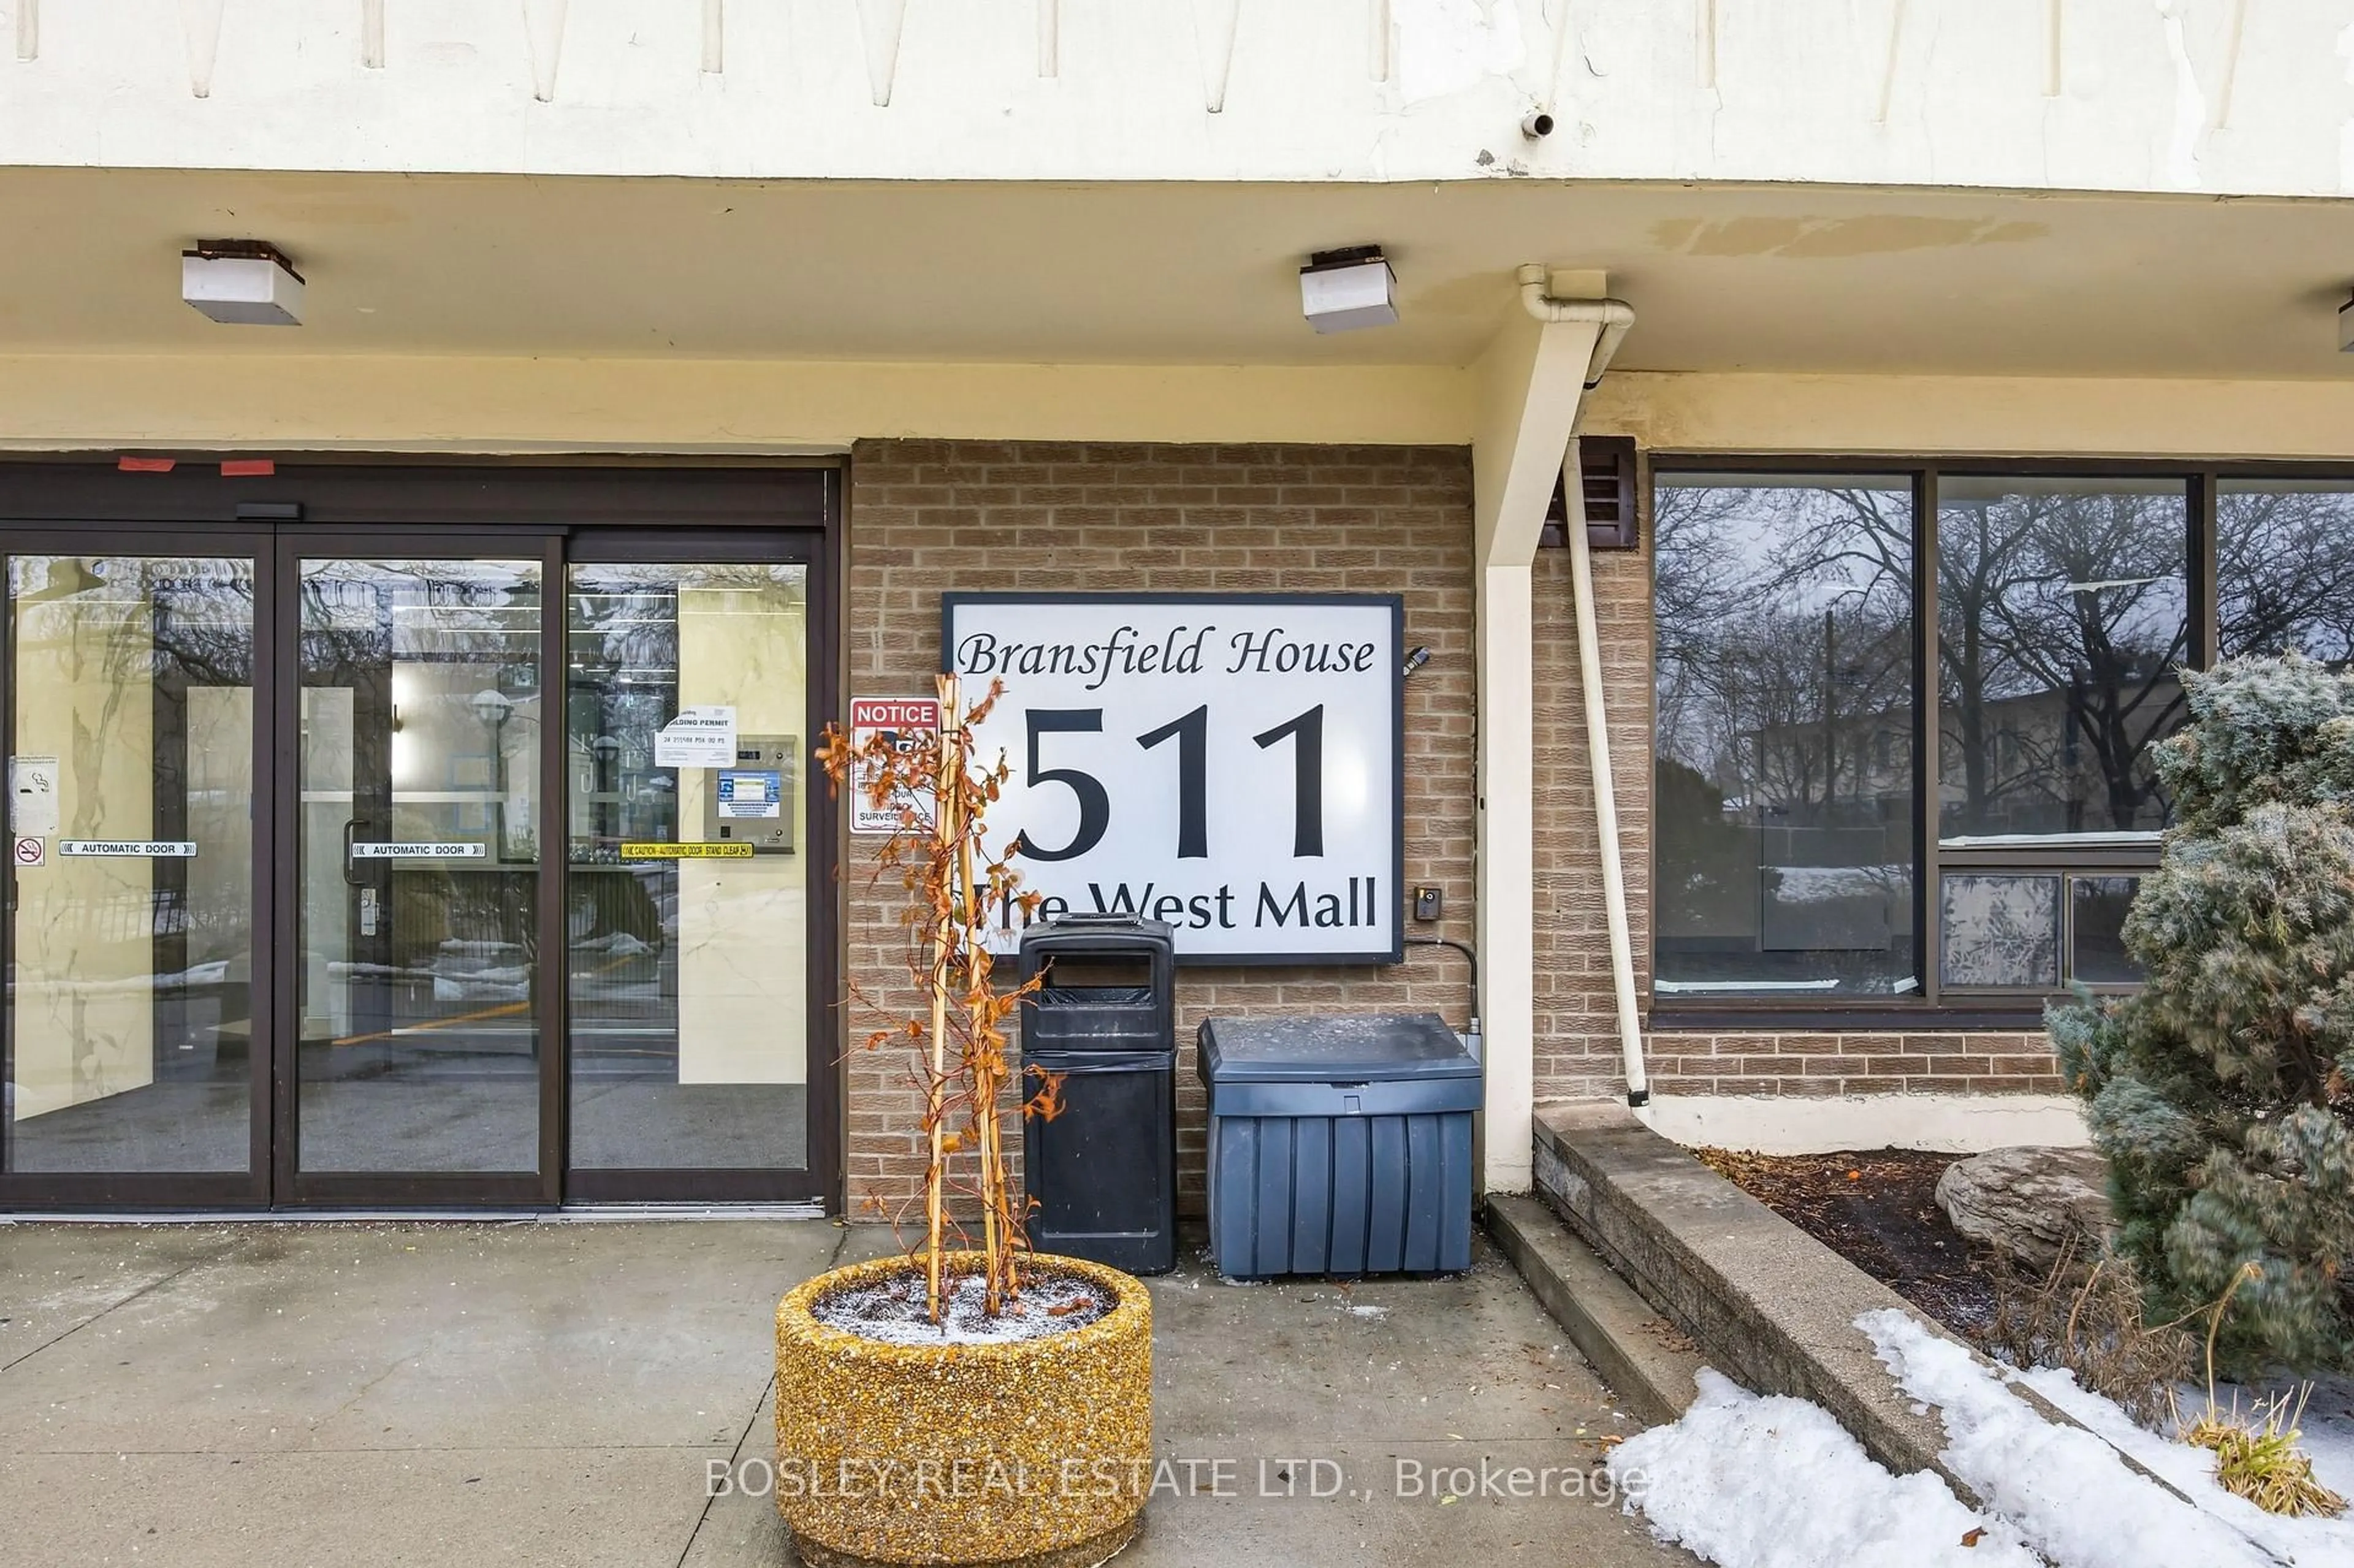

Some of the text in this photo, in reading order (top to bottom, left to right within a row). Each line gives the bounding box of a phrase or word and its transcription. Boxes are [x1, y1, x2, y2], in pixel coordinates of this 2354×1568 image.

[957, 626, 1374, 690] Bransfield House
[858, 706, 934, 722] NOTICE
[1018, 704, 1324, 862] 511
[82, 844, 176, 853] AUTOMATIC DOOR
[373, 846, 465, 854] AUTOMATIC DOOR
[1087, 883, 1237, 929] West
[1255, 877, 1376, 927] Mall
